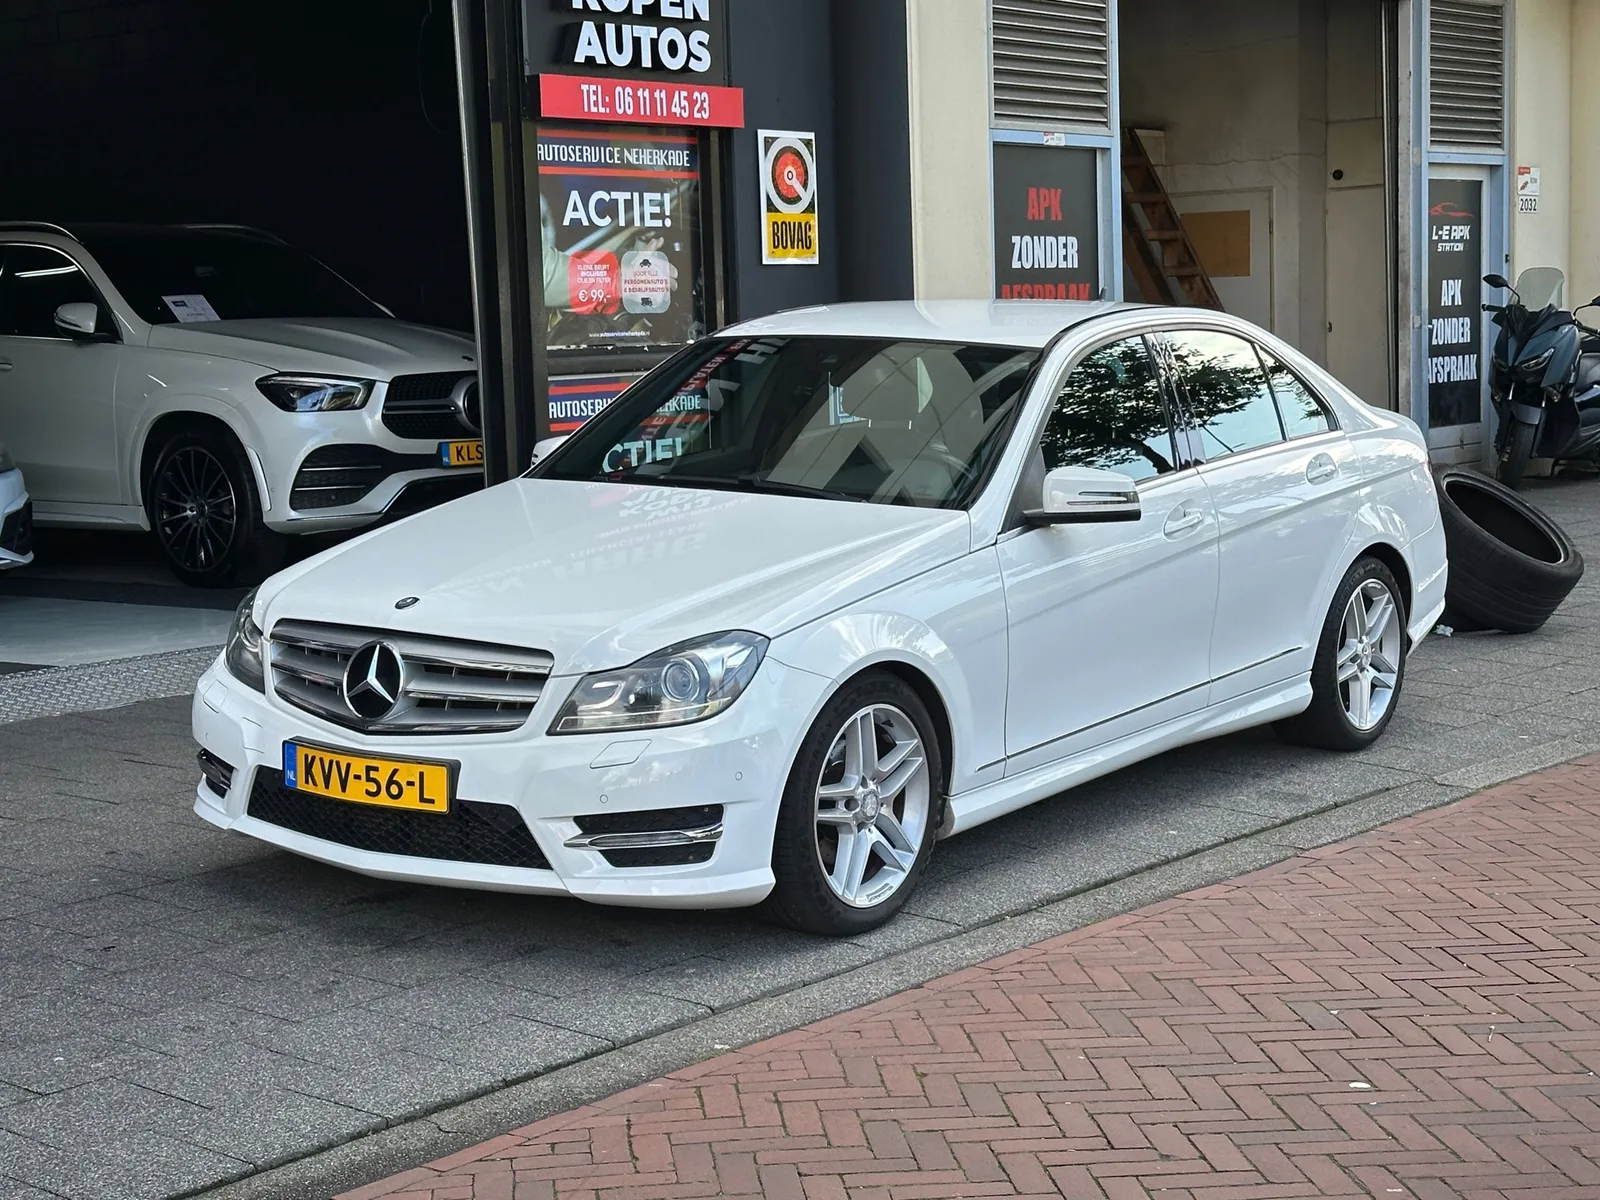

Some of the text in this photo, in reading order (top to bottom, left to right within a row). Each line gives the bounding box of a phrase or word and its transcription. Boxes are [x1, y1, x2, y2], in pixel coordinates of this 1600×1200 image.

[574, 20, 711, 72] AUTOS
[581, 84, 710, 120] TEL: 06 11 11 45 23
[536, 144, 691, 167] AUTOSERVICE NEHERKADE
[562, 190, 672, 228] ACTIE!
[1027, 187, 1062, 221] APK
[1520, 198, 1537, 212] 2032
[772, 221, 812, 250] BOVAG
[1450, 225, 1471, 240] APK
[1011, 235, 1079, 269] ZONDER
[1437, 242, 1464, 252] STATION
[578, 290, 612, 303] € 99,-
[1441, 279, 1462, 306] APK
[1431, 317, 1471, 345] ZONDER
[1428, 354, 1478, 384] AFSPRAAK
[456, 444, 484, 462] KLS
[602, 437, 683, 473] CTIE!
[287, 770, 297, 781] NL
[304, 753, 436, 805] KVV-56-L
